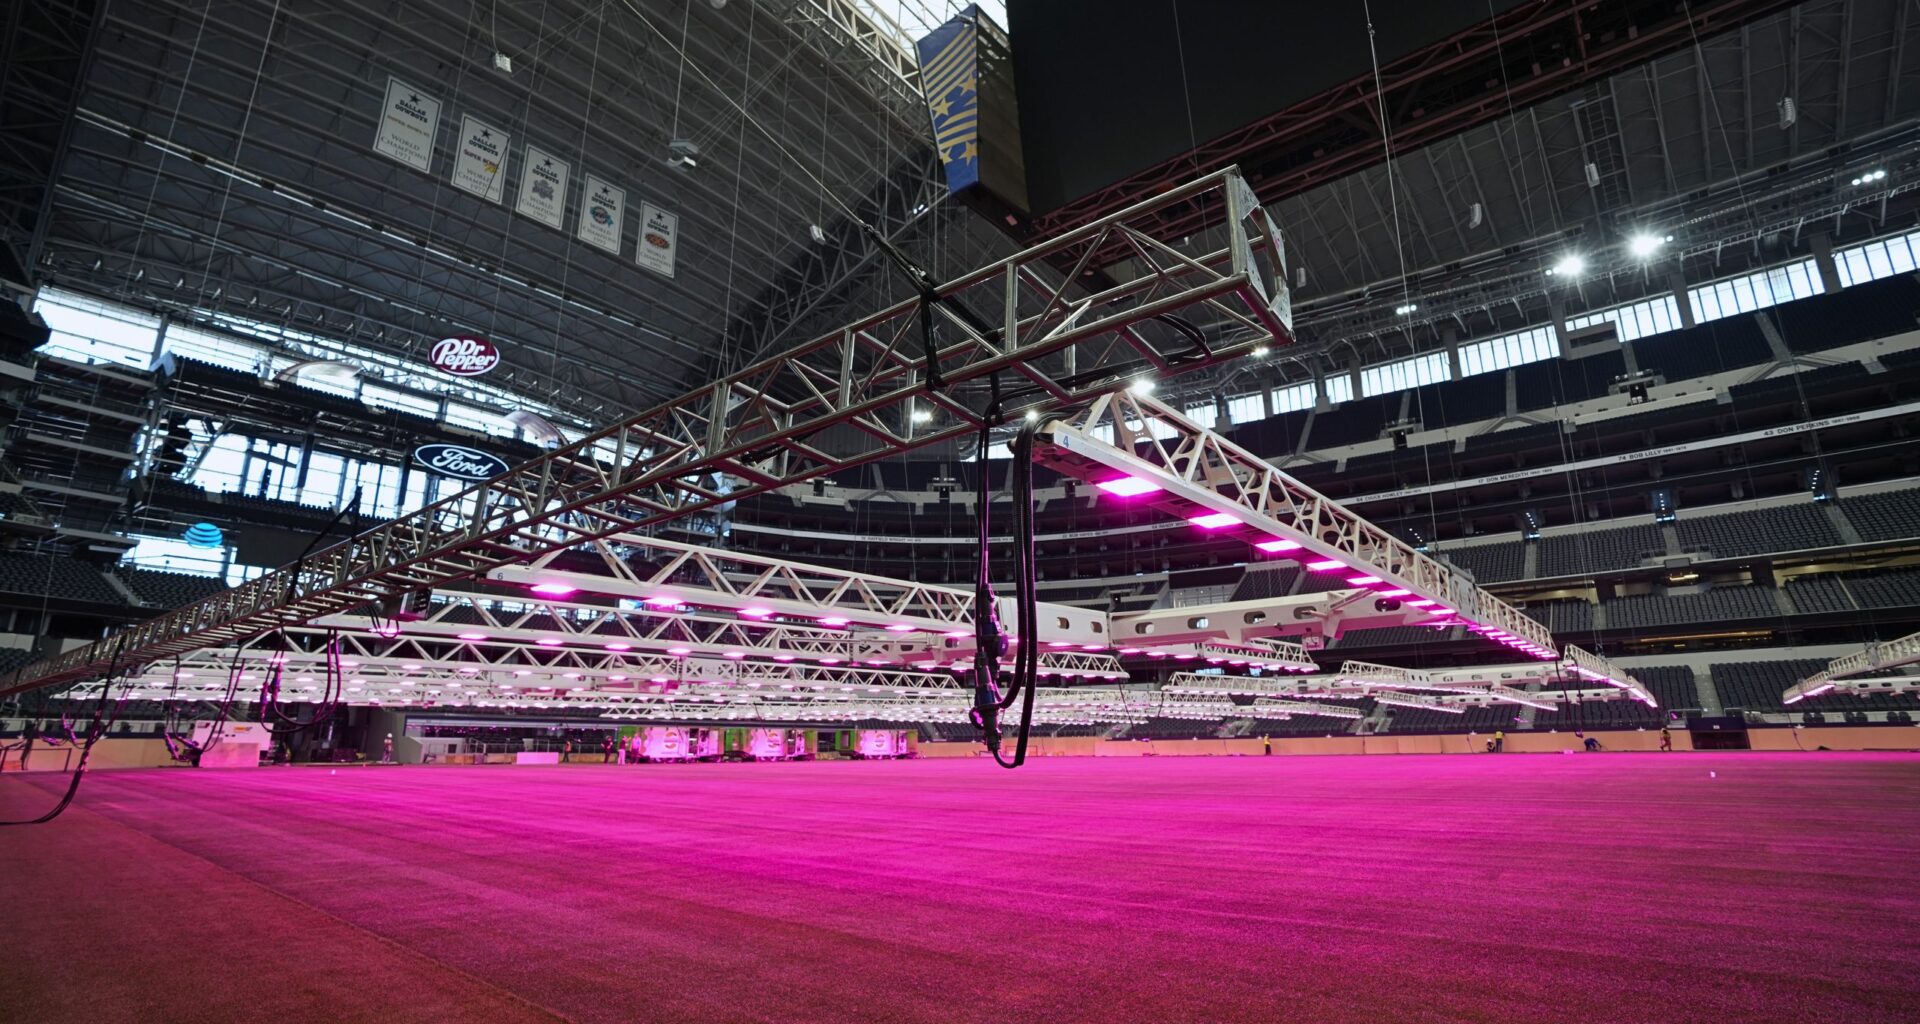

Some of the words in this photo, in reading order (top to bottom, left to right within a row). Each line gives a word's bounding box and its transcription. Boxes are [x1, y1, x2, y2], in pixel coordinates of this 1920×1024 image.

[395, 103, 428, 123] COWBOYS
[400, 99, 426, 116] DALLAS
[380, 136, 427, 161] CHAMPIONS
[391, 133, 420, 151] WORLD
[469, 139, 498, 156] COWBOYS
[472, 135, 497, 150] DALLAS
[464, 149, 481, 161] SUPER
[532, 168, 560, 184] COWBOYS
[536, 164, 558, 178] DALLAS
[591, 196, 617, 211] COWBOYS
[594, 192, 615, 205] DALLAS
[647, 222, 670, 236] COWBOYS
[650, 219, 669, 230] DALLAS
[432, 338, 496, 370] Pepper
[458, 339, 485, 356] Dr
[1777, 426, 1794, 434] DON
[1796, 420, 1830, 431] PERKINS
[1063, 435, 1070, 448] 4
[432, 448, 494, 477] Ford
[1629, 452, 1643, 460] BOB
[1500, 471, 1529, 480] MEREDITH
[497, 572, 503, 580] 6
